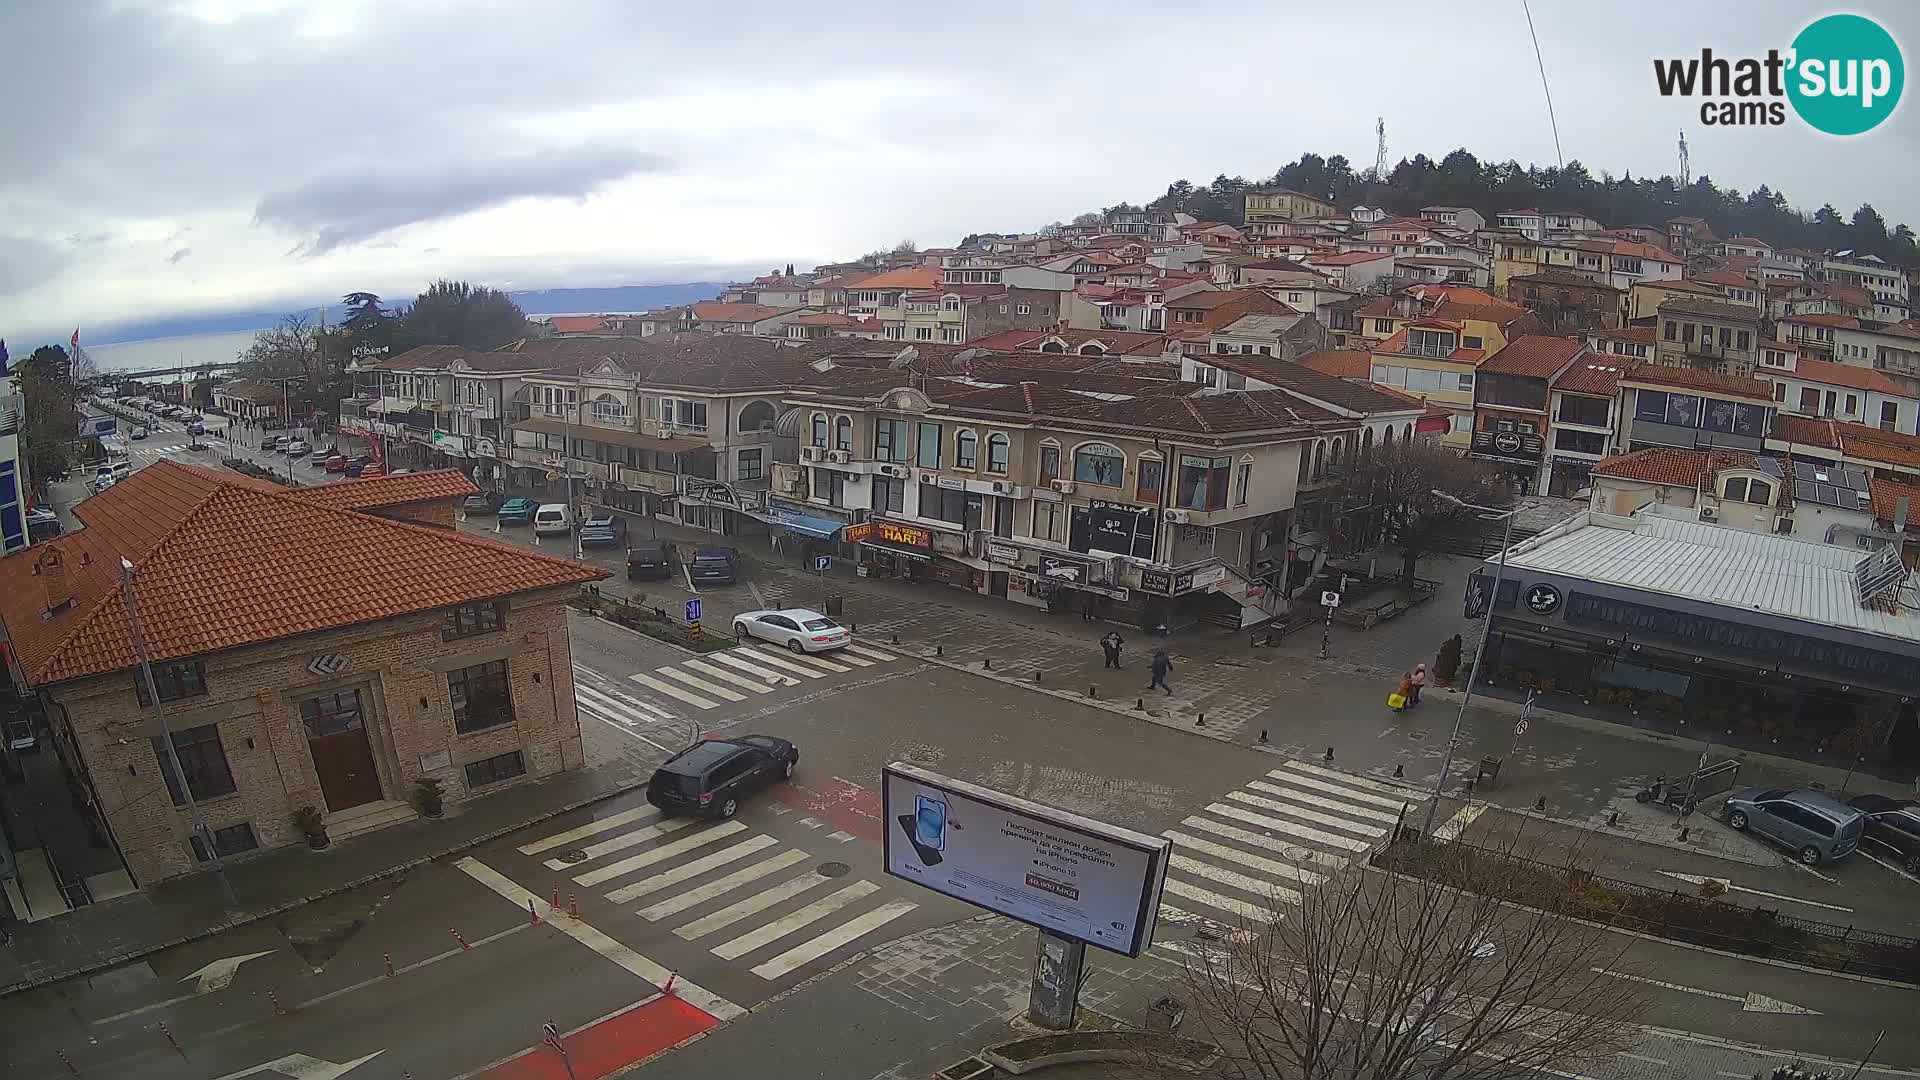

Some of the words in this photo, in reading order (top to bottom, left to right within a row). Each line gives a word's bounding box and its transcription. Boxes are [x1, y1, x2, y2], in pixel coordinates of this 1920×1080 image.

[820, 558, 826, 569] P
[1005, 820, 1044, 837] Постојат
[1082, 844, 1112, 858] добри
[1036, 847, 1047, 856] на
[1039, 860, 1066, 874] iPhone
